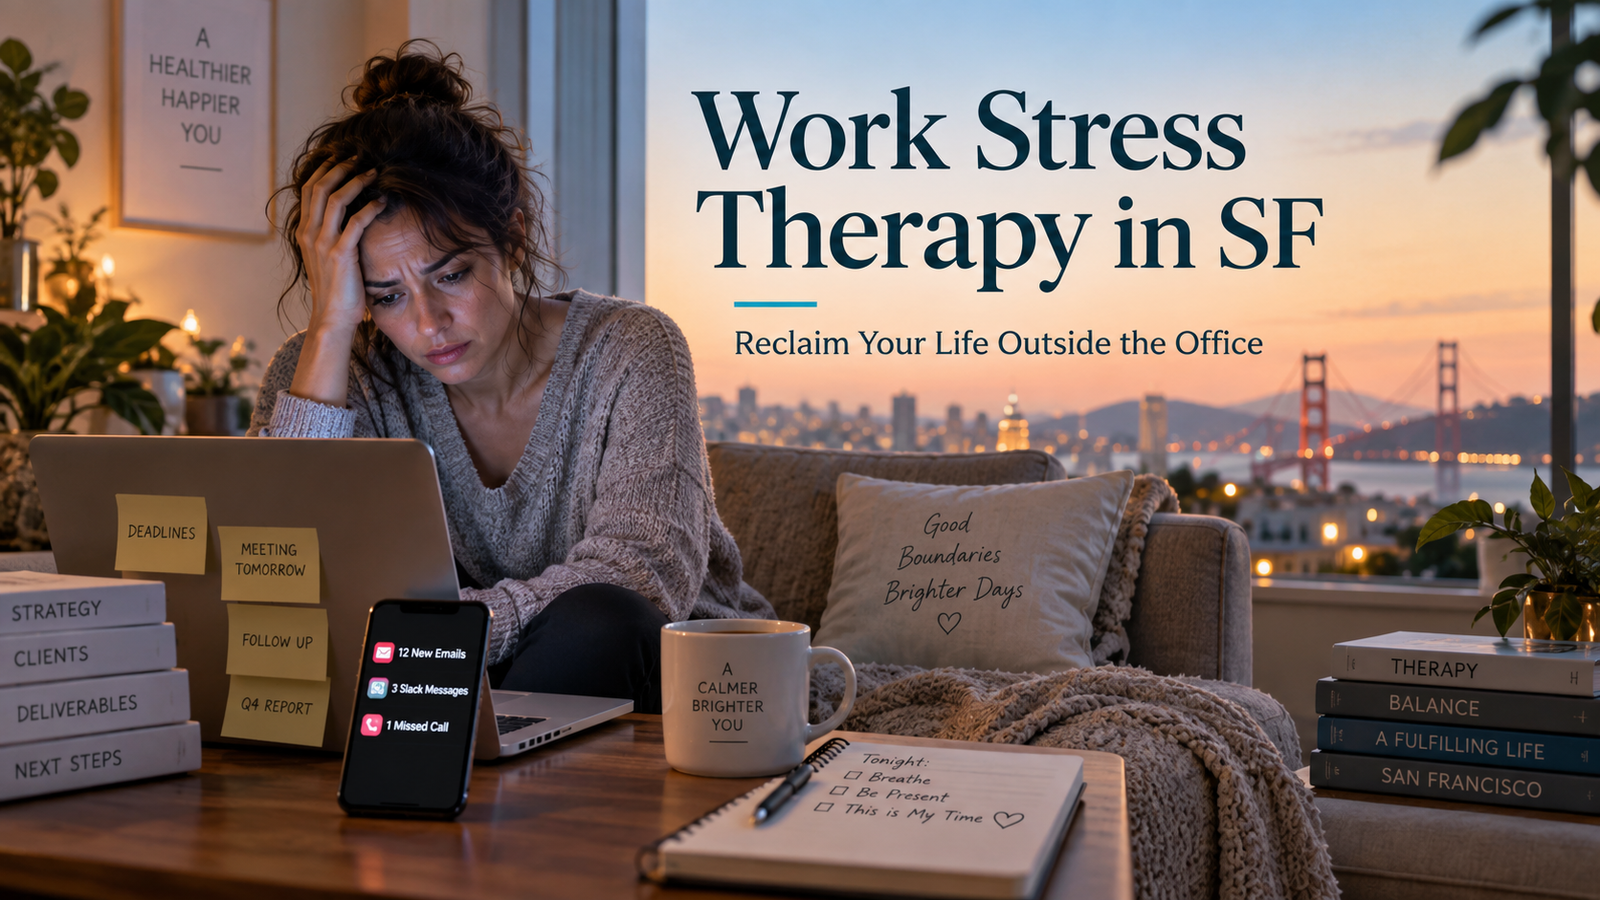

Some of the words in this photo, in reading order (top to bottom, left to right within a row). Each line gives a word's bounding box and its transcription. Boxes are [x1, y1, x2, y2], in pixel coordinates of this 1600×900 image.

[196, 28, 210, 48] A
[150, 54, 250, 84] HEALTHIER
[162, 89, 239, 114] HAPPIER
[181, 123, 221, 144] YOU
[128, 525, 195, 539] DEADLINES
[924, 512, 973, 538] Good
[242, 543, 297, 556] MEETING
[898, 543, 1001, 570] Boundaries
[236, 563, 305, 576] TOMORROW
[884, 578, 966, 611] Brighter
[974, 577, 1023, 609] Days
[13, 600, 101, 621] STRATEGY
[243, 633, 291, 647] FOLLOW
[297, 636, 313, 649] UP
[14, 646, 88, 667] CLIENTS
[397, 647, 409, 658] 12
[411, 648, 433, 657] New
[435, 649, 466, 659] Emails
[722, 662, 732, 675] A
[1392, 658, 1478, 678] THERAPY
[391, 683, 399, 694] 3
[399, 683, 423, 694] Slack
[425, 685, 468, 697] Messages
[698, 682, 757, 694] CALMER
[18, 695, 137, 722] DELIVERABLES
[242, 697, 259, 711] Q4
[265, 699, 313, 714] REPORT
[693, 700, 763, 712] BRIGHTER
[1390, 695, 1479, 716] BALANCE
[385, 720, 392, 731] 1
[393, 720, 428, 732] Missed
[430, 722, 449, 732] Call
[712, 719, 742, 731] YOU
[1376, 731, 1387, 746] A
[1396, 732, 1498, 755] FULFILLING
[1507, 742, 1544, 760] LIFE
[16, 758, 61, 779] NEXT
[71, 750, 121, 771] STEPS
[862, 753, 929, 770] Tonight:
[869, 772, 930, 784] Breathe
[1382, 768, 1419, 786] SAN
[1429, 772, 1541, 798] FRANCISCO
[857, 788, 878, 797] Be
[886, 789, 949, 802] Present
[846, 804, 878, 815] This
[886, 806, 899, 817] is
[907, 809, 935, 824] My
[946, 811, 982, 822] Time
